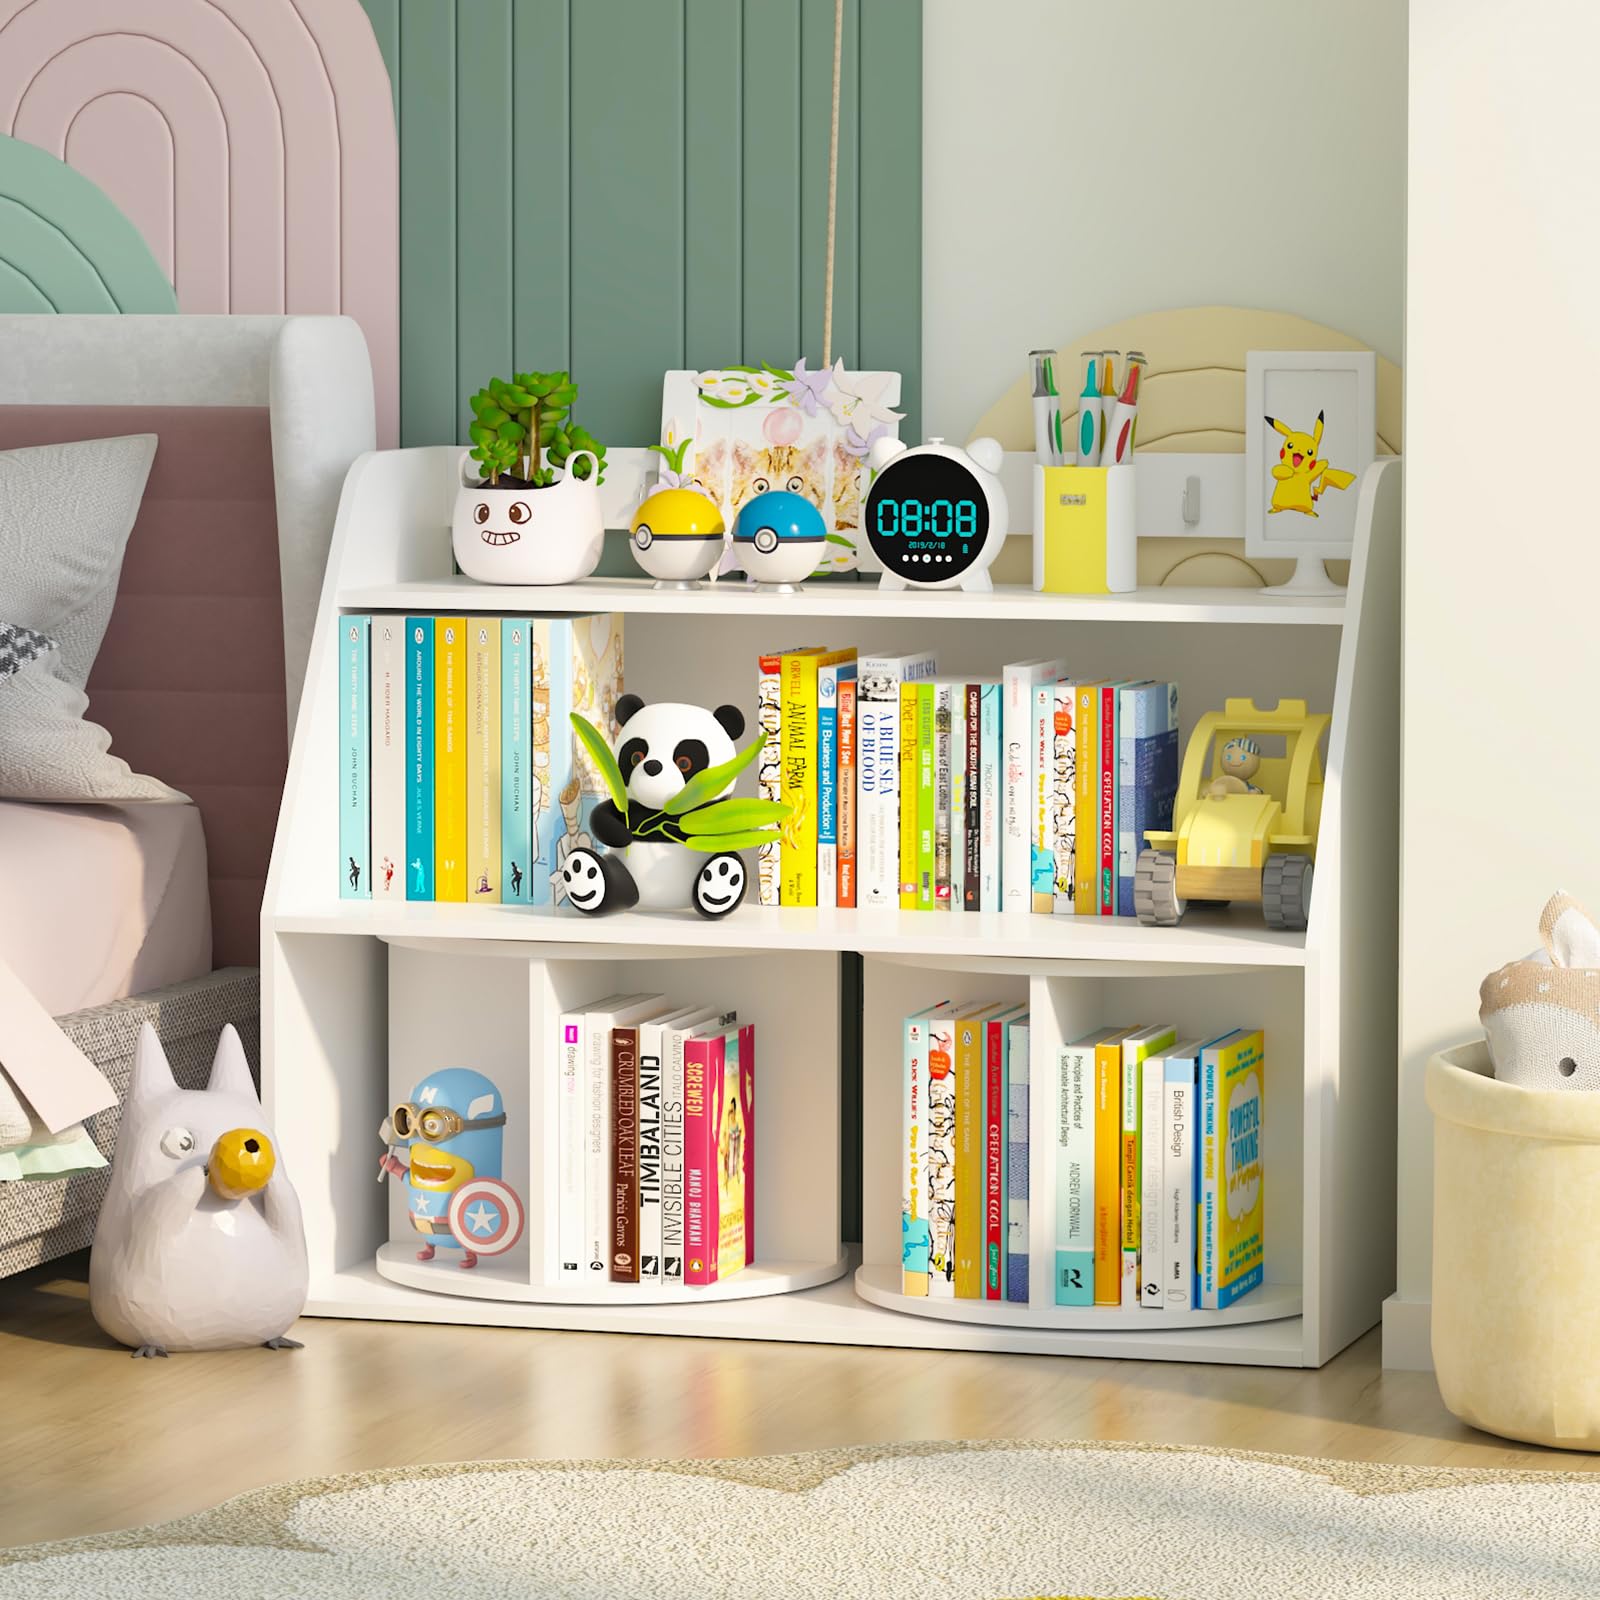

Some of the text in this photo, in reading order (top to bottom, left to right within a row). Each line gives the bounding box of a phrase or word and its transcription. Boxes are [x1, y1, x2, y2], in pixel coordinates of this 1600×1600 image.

[877, 499, 977, 538] 08:08
[908, 541, 946, 550] 2019/2/18
[790, 660, 802, 698] ORWELL
[879, 712, 894, 721] A
[902, 698, 918, 721] Poet
[969, 717, 977, 732] FOR
[416, 726, 423, 735] IN
[787, 702, 807, 790] ANIMAL FARM
[879, 727, 894, 766] BLUE
[937, 733, 948, 758] Names
[969, 733, 977, 746] THE
[822, 729, 833, 769] Business
[841, 750, 852, 765] See
[862, 714, 876, 792] OF BLOOD
[902, 738, 918, 762] Poet
[937, 759, 948, 767] of
[969, 747, 977, 770] SOUTH
[822, 770, 833, 785] and
[879, 768, 894, 795] SEA
[937, 767, 948, 784] East
[969, 770, 977, 790] ASIAN
[984, 763, 993, 797] THOUGHT
[822, 786, 833, 829] Production
[937, 785, 948, 811] Lothian
[969, 791, 977, 809] SOUL
[1103, 771, 1112, 858] OPERATION COOL
[564, 1046, 577, 1076] drawing
[589, 1032, 604, 1066] drawing
[589, 1067, 604, 1079] for
[672, 1034, 682, 1099] ITALO CALVINO
[910, 1058, 918, 1082] SLICK
[1072, 1055, 1083, 1084] Principles
[1206, 1064, 1214, 1100] POWERFUL
[589, 1081, 604, 1111] fashion
[1059, 1055, 1069, 1147] Sustainable Architectural Design
[1072, 1084, 1083, 1094] and
[618, 1051, 635, 1177] CRUMBLED OAK LEAF
[1072, 1095, 1083, 1122] Practices
[1173, 1090, 1184, 1158] British Design
[1206, 1102, 1214, 1135] THINKING
[1229, 1095, 1259, 1141] POWERFUL
[589, 1113, 604, 1154] designers
[639, 1055, 661, 1208] TIMBALAND
[663, 1101, 682, 1246] INVISIBLE CITIES
[989, 1123, 1000, 1232] OPERATION COOL
[1206, 1148, 1214, 1179] PURPOSE
[688, 1168, 703, 1247] MANOJ BHAVNANI
[1069, 1162, 1081, 1239] ANDREW CORNWALL
[1126, 1140, 1134, 1244] Tampil Cantik dengan Herbal
[616, 1183, 629, 1247] Patricia Gavros
[1145, 1211, 1159, 1254] course
